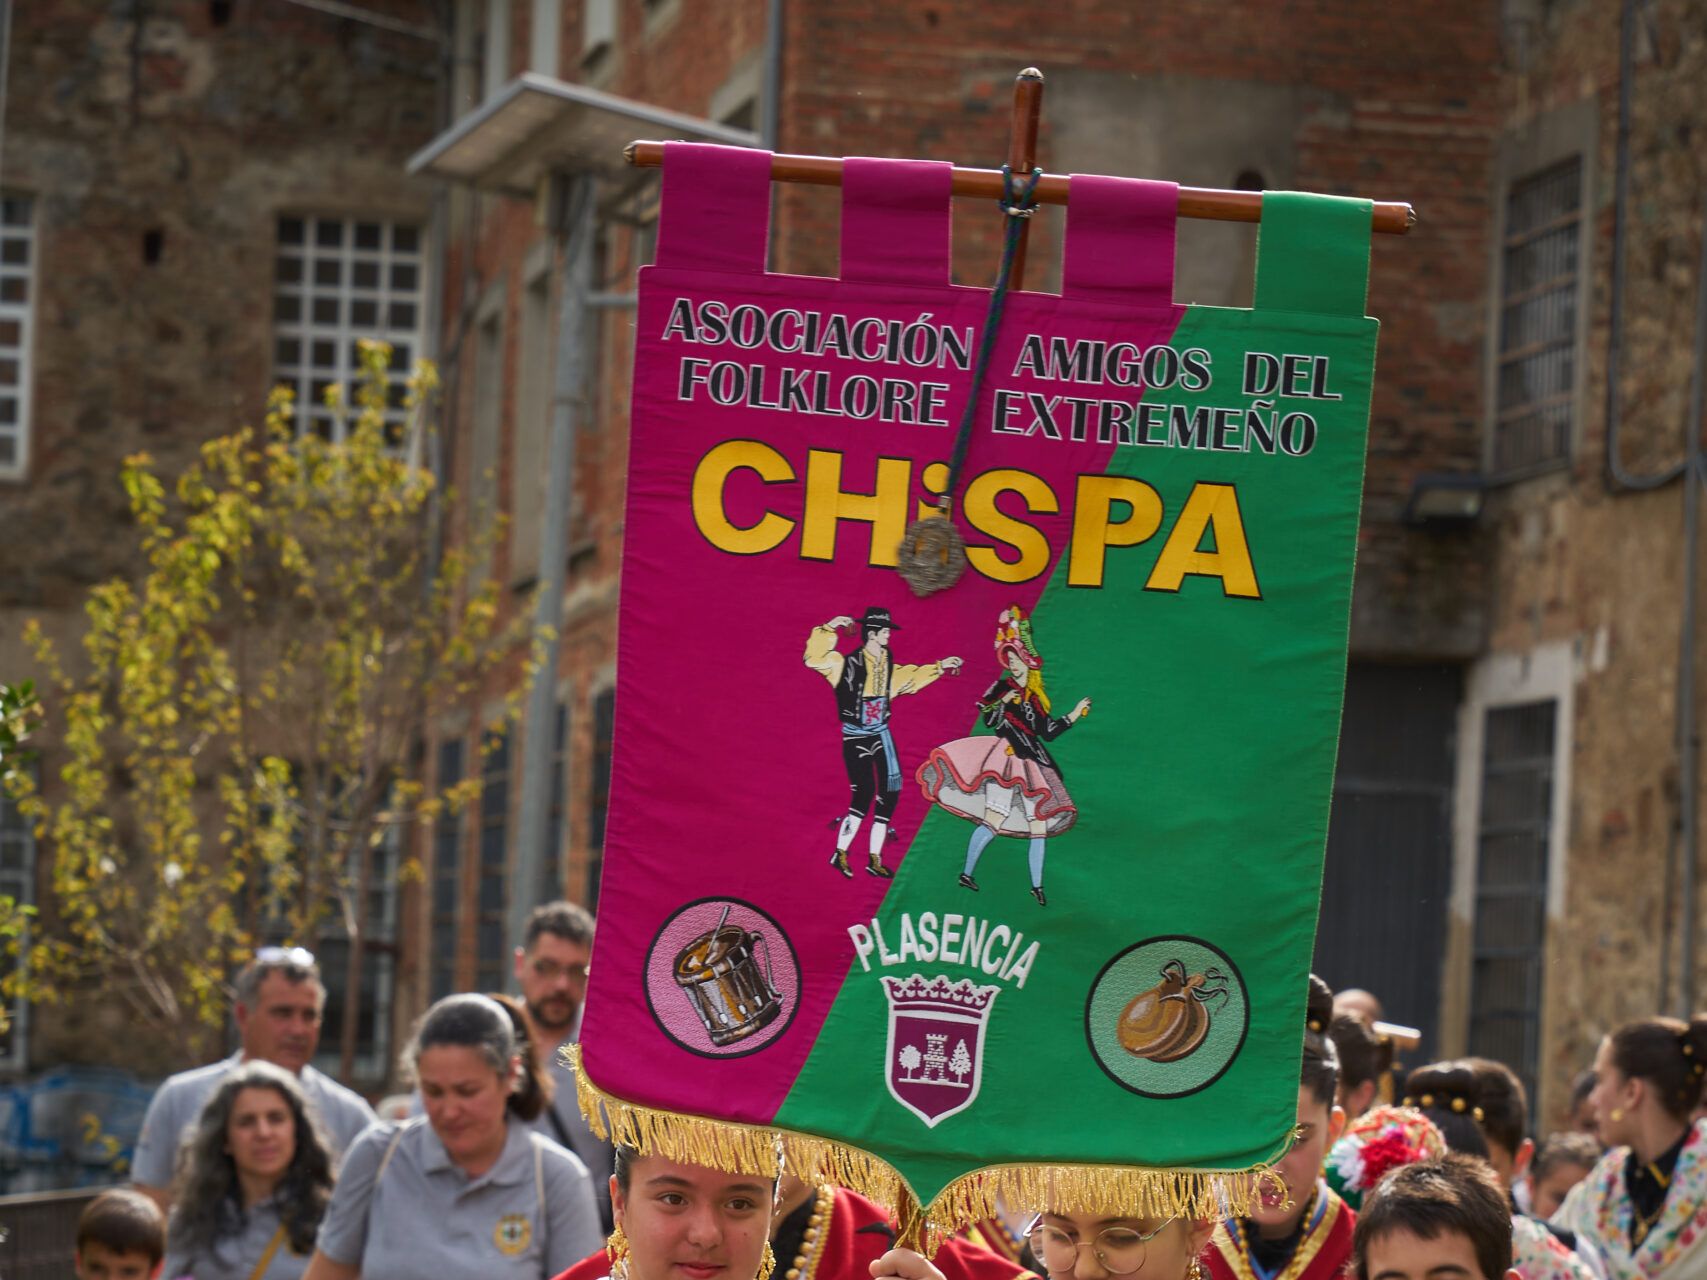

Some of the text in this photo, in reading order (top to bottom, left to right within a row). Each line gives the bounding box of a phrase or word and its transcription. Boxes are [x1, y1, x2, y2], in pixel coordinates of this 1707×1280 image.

[661, 297, 1343, 400] ASOCIACIÓN AMIGOS DEL
[678, 357, 1318, 457] FOLKLORE EXTREMEÑO
[847, 911, 1041, 989] PLASENCIA
